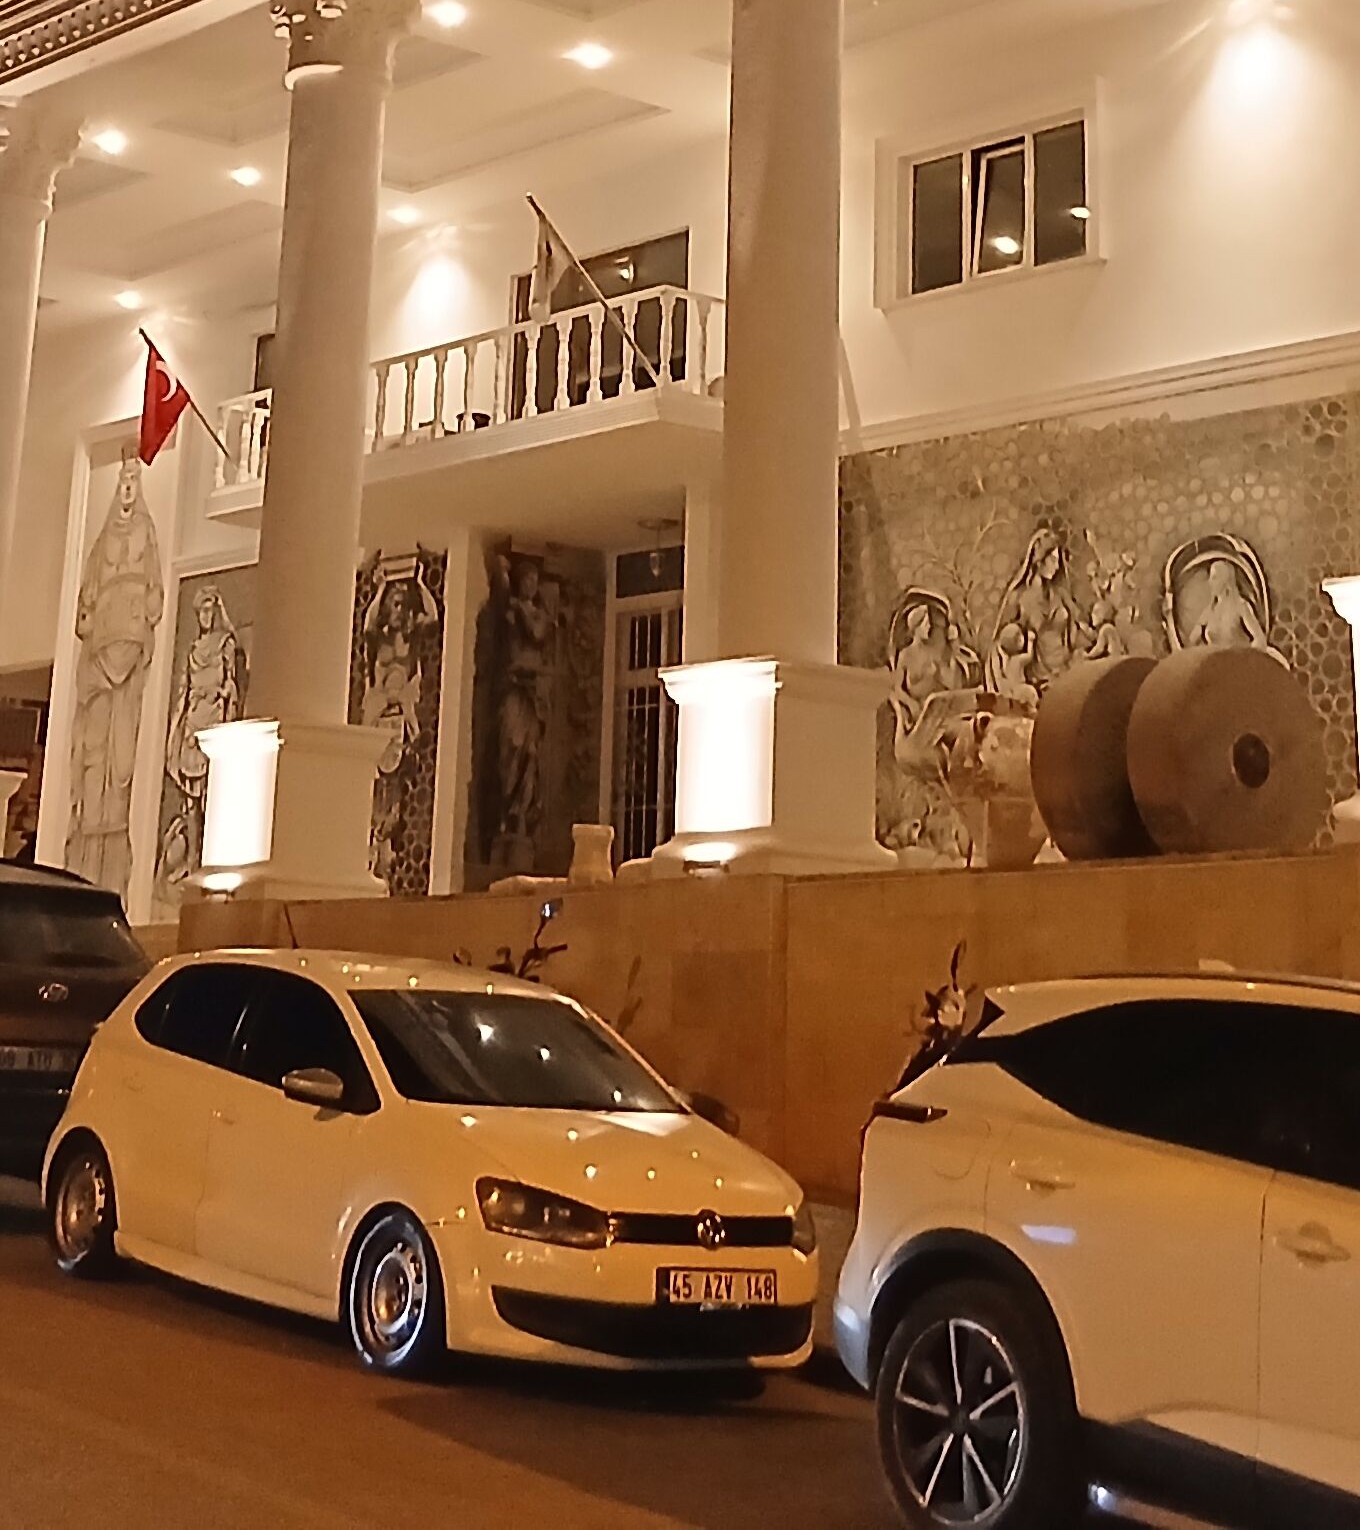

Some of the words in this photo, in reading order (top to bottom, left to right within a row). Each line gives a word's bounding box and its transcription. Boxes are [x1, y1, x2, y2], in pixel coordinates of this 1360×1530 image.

[672, 1273, 692, 1299] 45
[704, 1274, 733, 1300] AZV
[746, 1275, 772, 1300] 148
